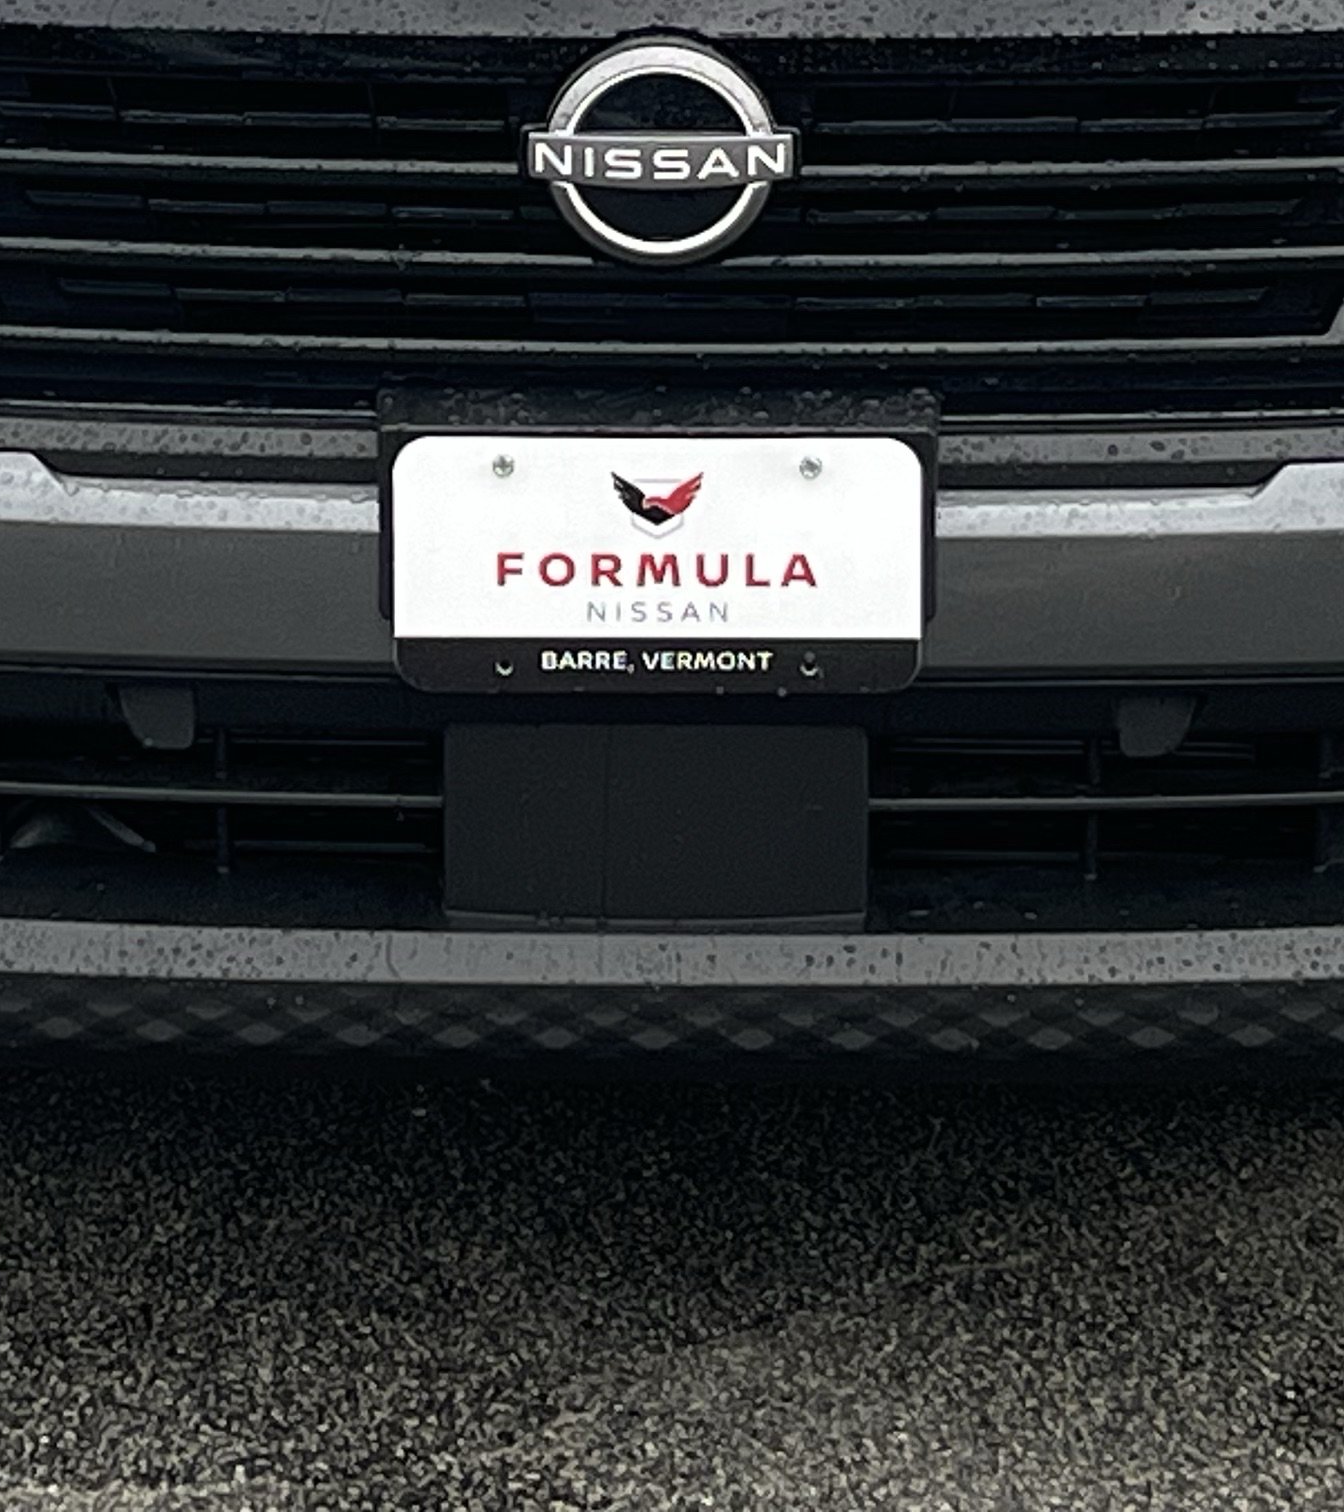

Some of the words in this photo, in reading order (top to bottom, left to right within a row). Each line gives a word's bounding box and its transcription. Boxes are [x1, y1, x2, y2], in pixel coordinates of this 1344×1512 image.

[534, 141, 786, 181] NISSAN
[496, 551, 818, 588] FORMULA
[585, 600, 731, 623] NISSAN
[541, 650, 636, 673] BARRE,
[642, 650, 774, 672] VERMONT
